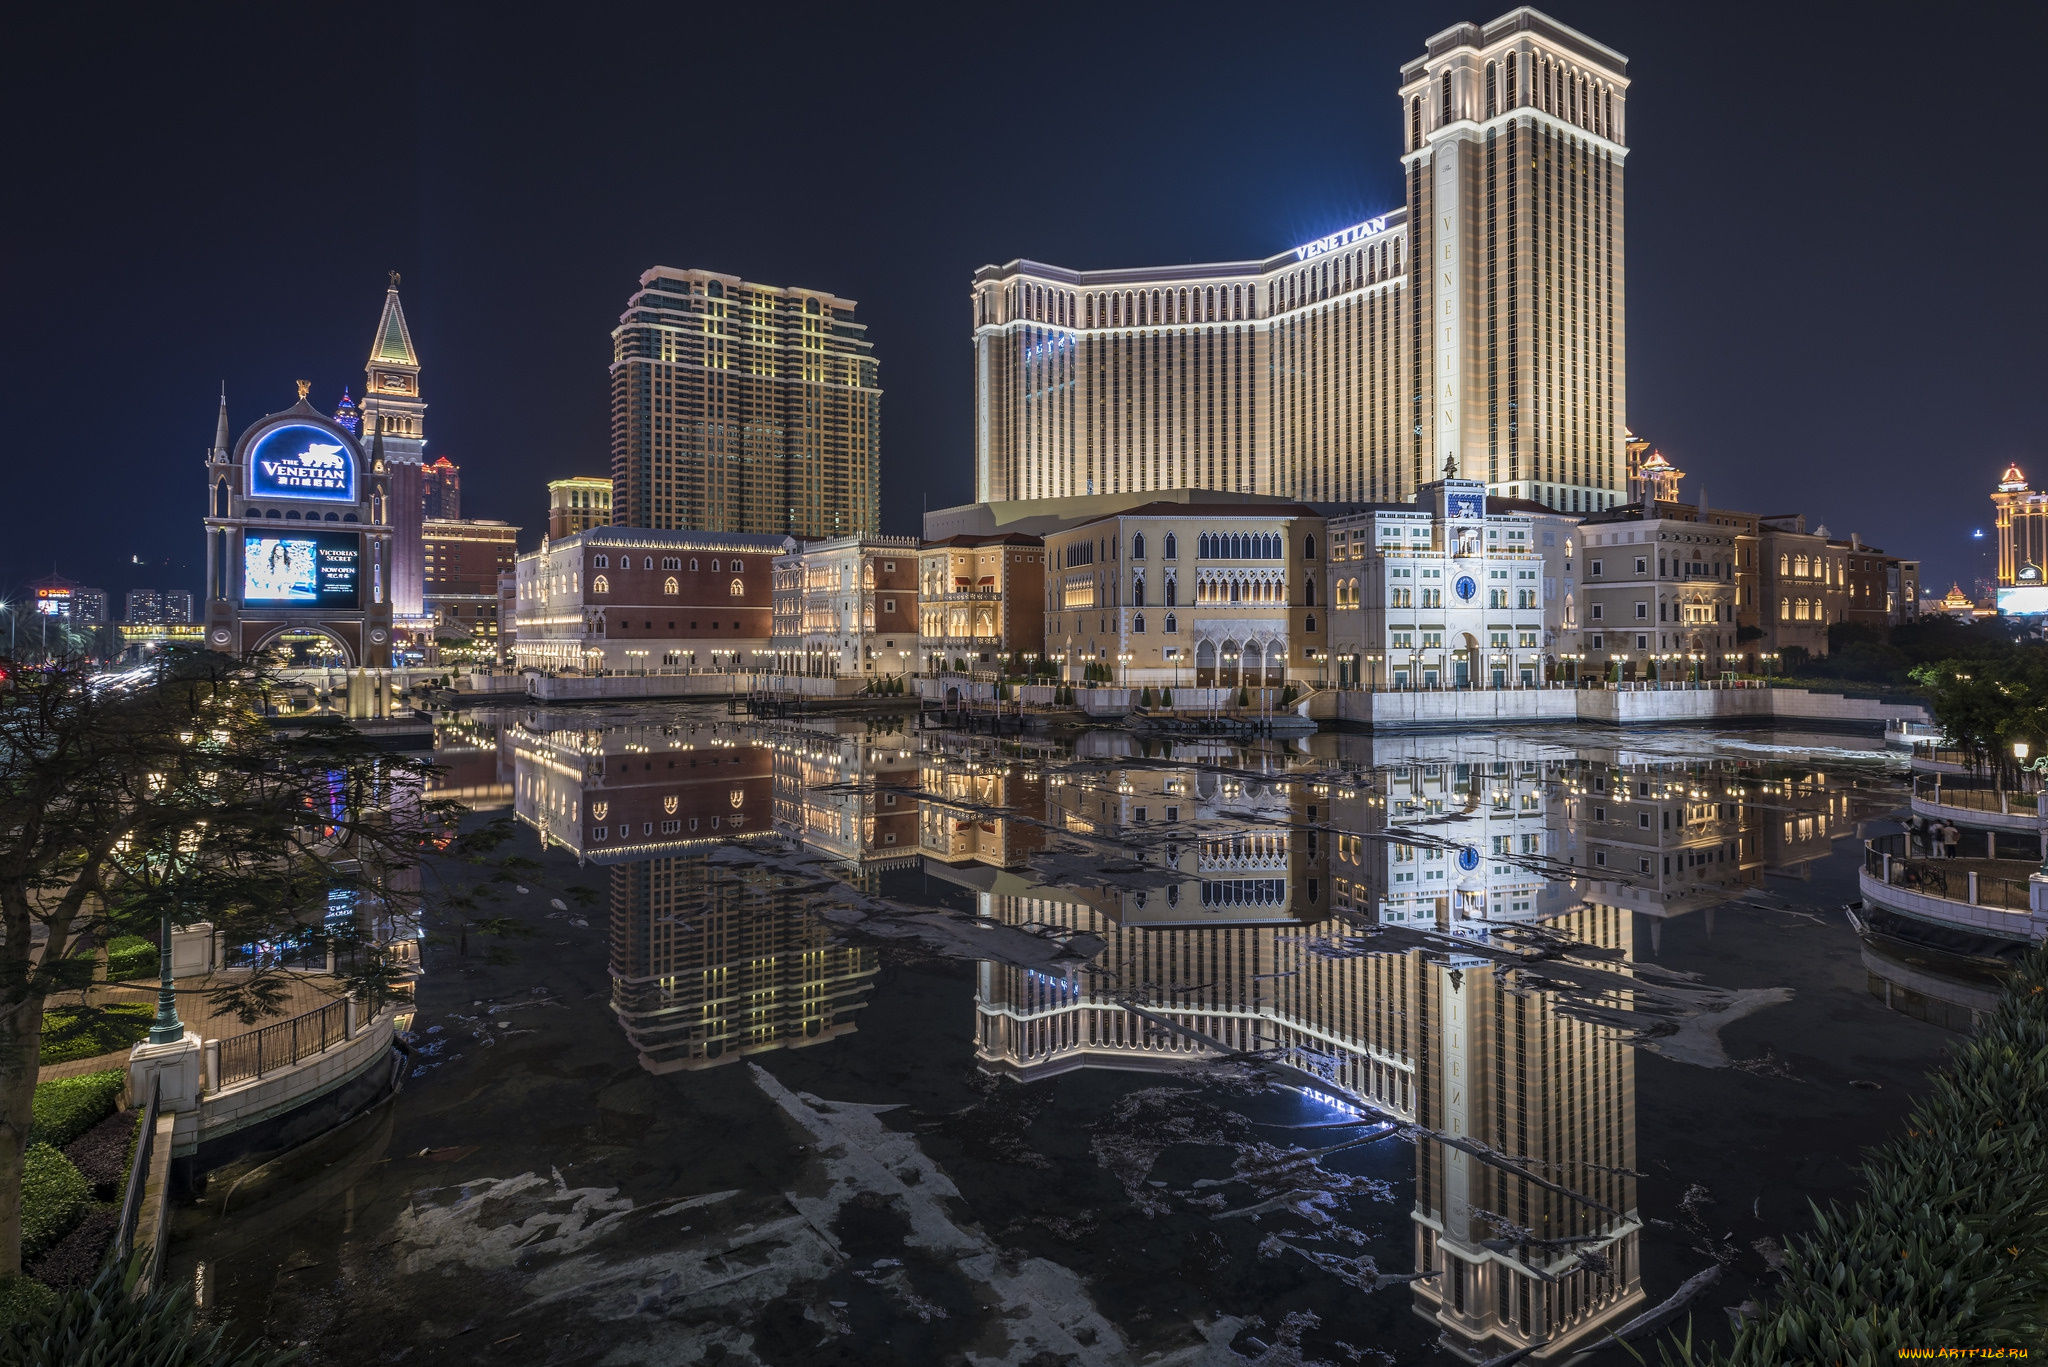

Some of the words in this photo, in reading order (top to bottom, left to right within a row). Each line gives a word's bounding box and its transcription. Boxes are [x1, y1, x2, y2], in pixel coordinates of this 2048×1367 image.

[1296, 216, 1386, 261] VENETIAN
[1443, 216, 1453, 426] VENETIAN
[261, 461, 345, 479] VENETIAN
[319, 549, 358, 557] VICTORIA'S
